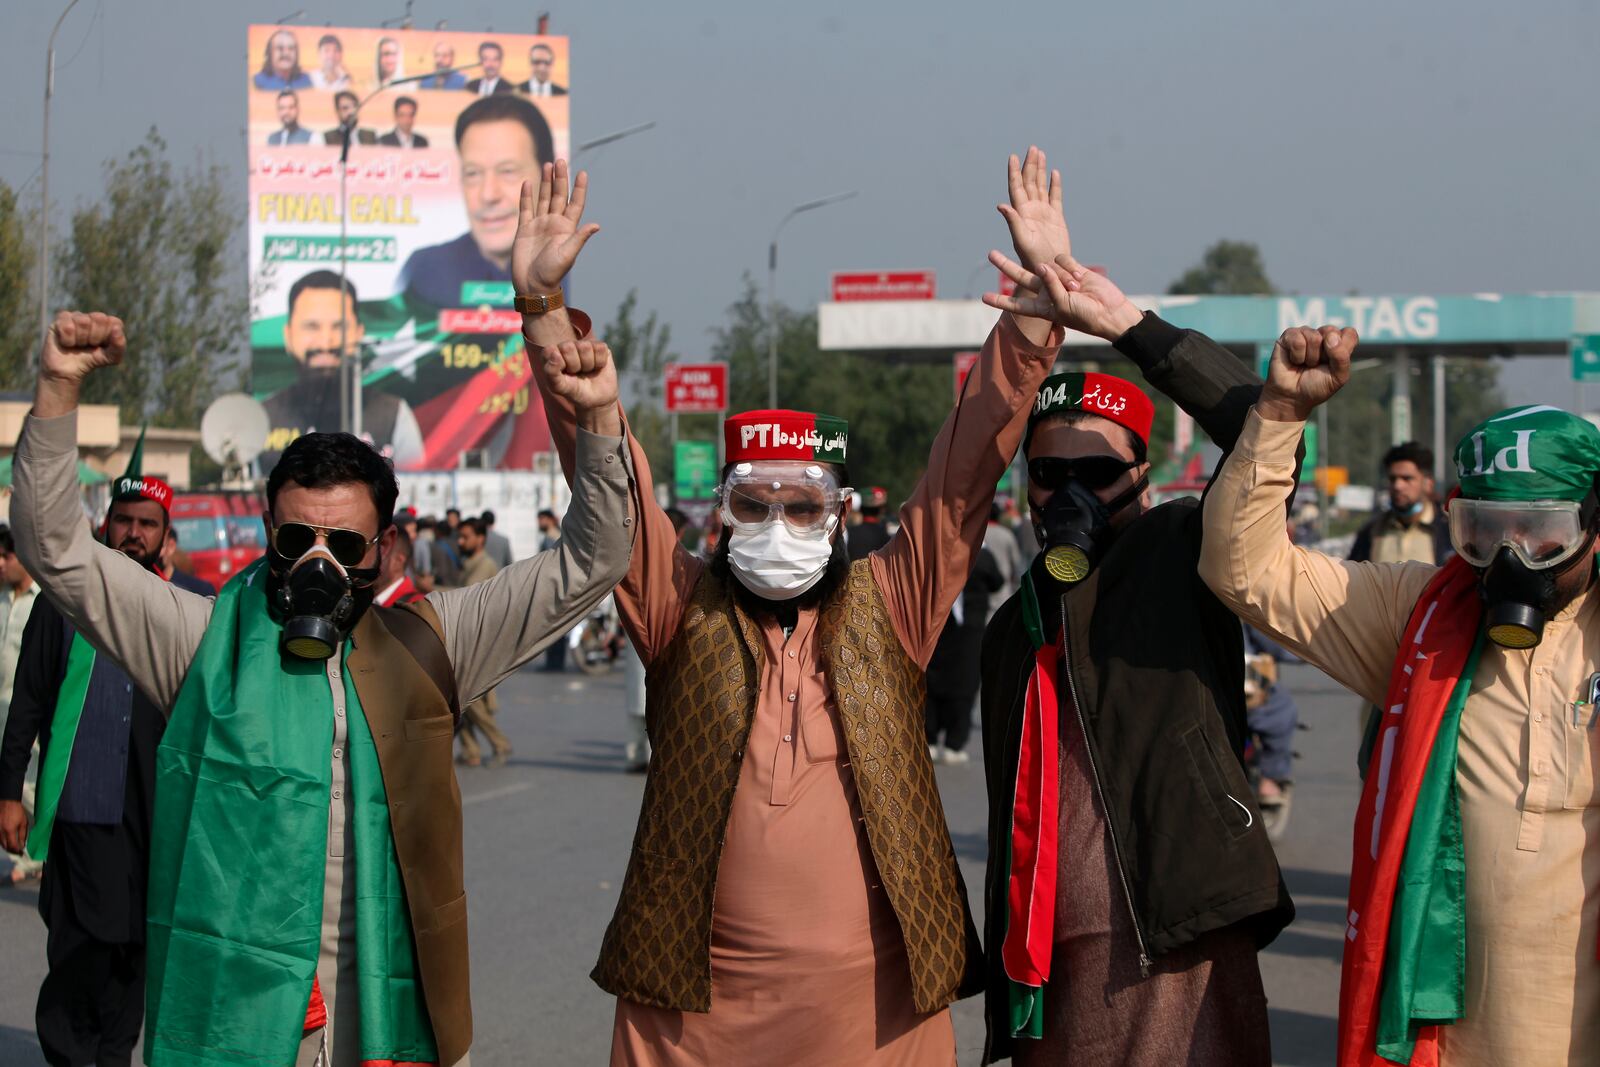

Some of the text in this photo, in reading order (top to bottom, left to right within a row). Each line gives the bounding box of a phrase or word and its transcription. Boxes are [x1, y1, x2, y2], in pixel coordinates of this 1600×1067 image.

[258, 194, 420, 225] FINAL CALL
[1278, 296, 1438, 338] M-TAG
[1074, 384, 1102, 405] نمبر
[1096, 393, 1127, 415] قیدی
[740, 424, 780, 449] PTI
